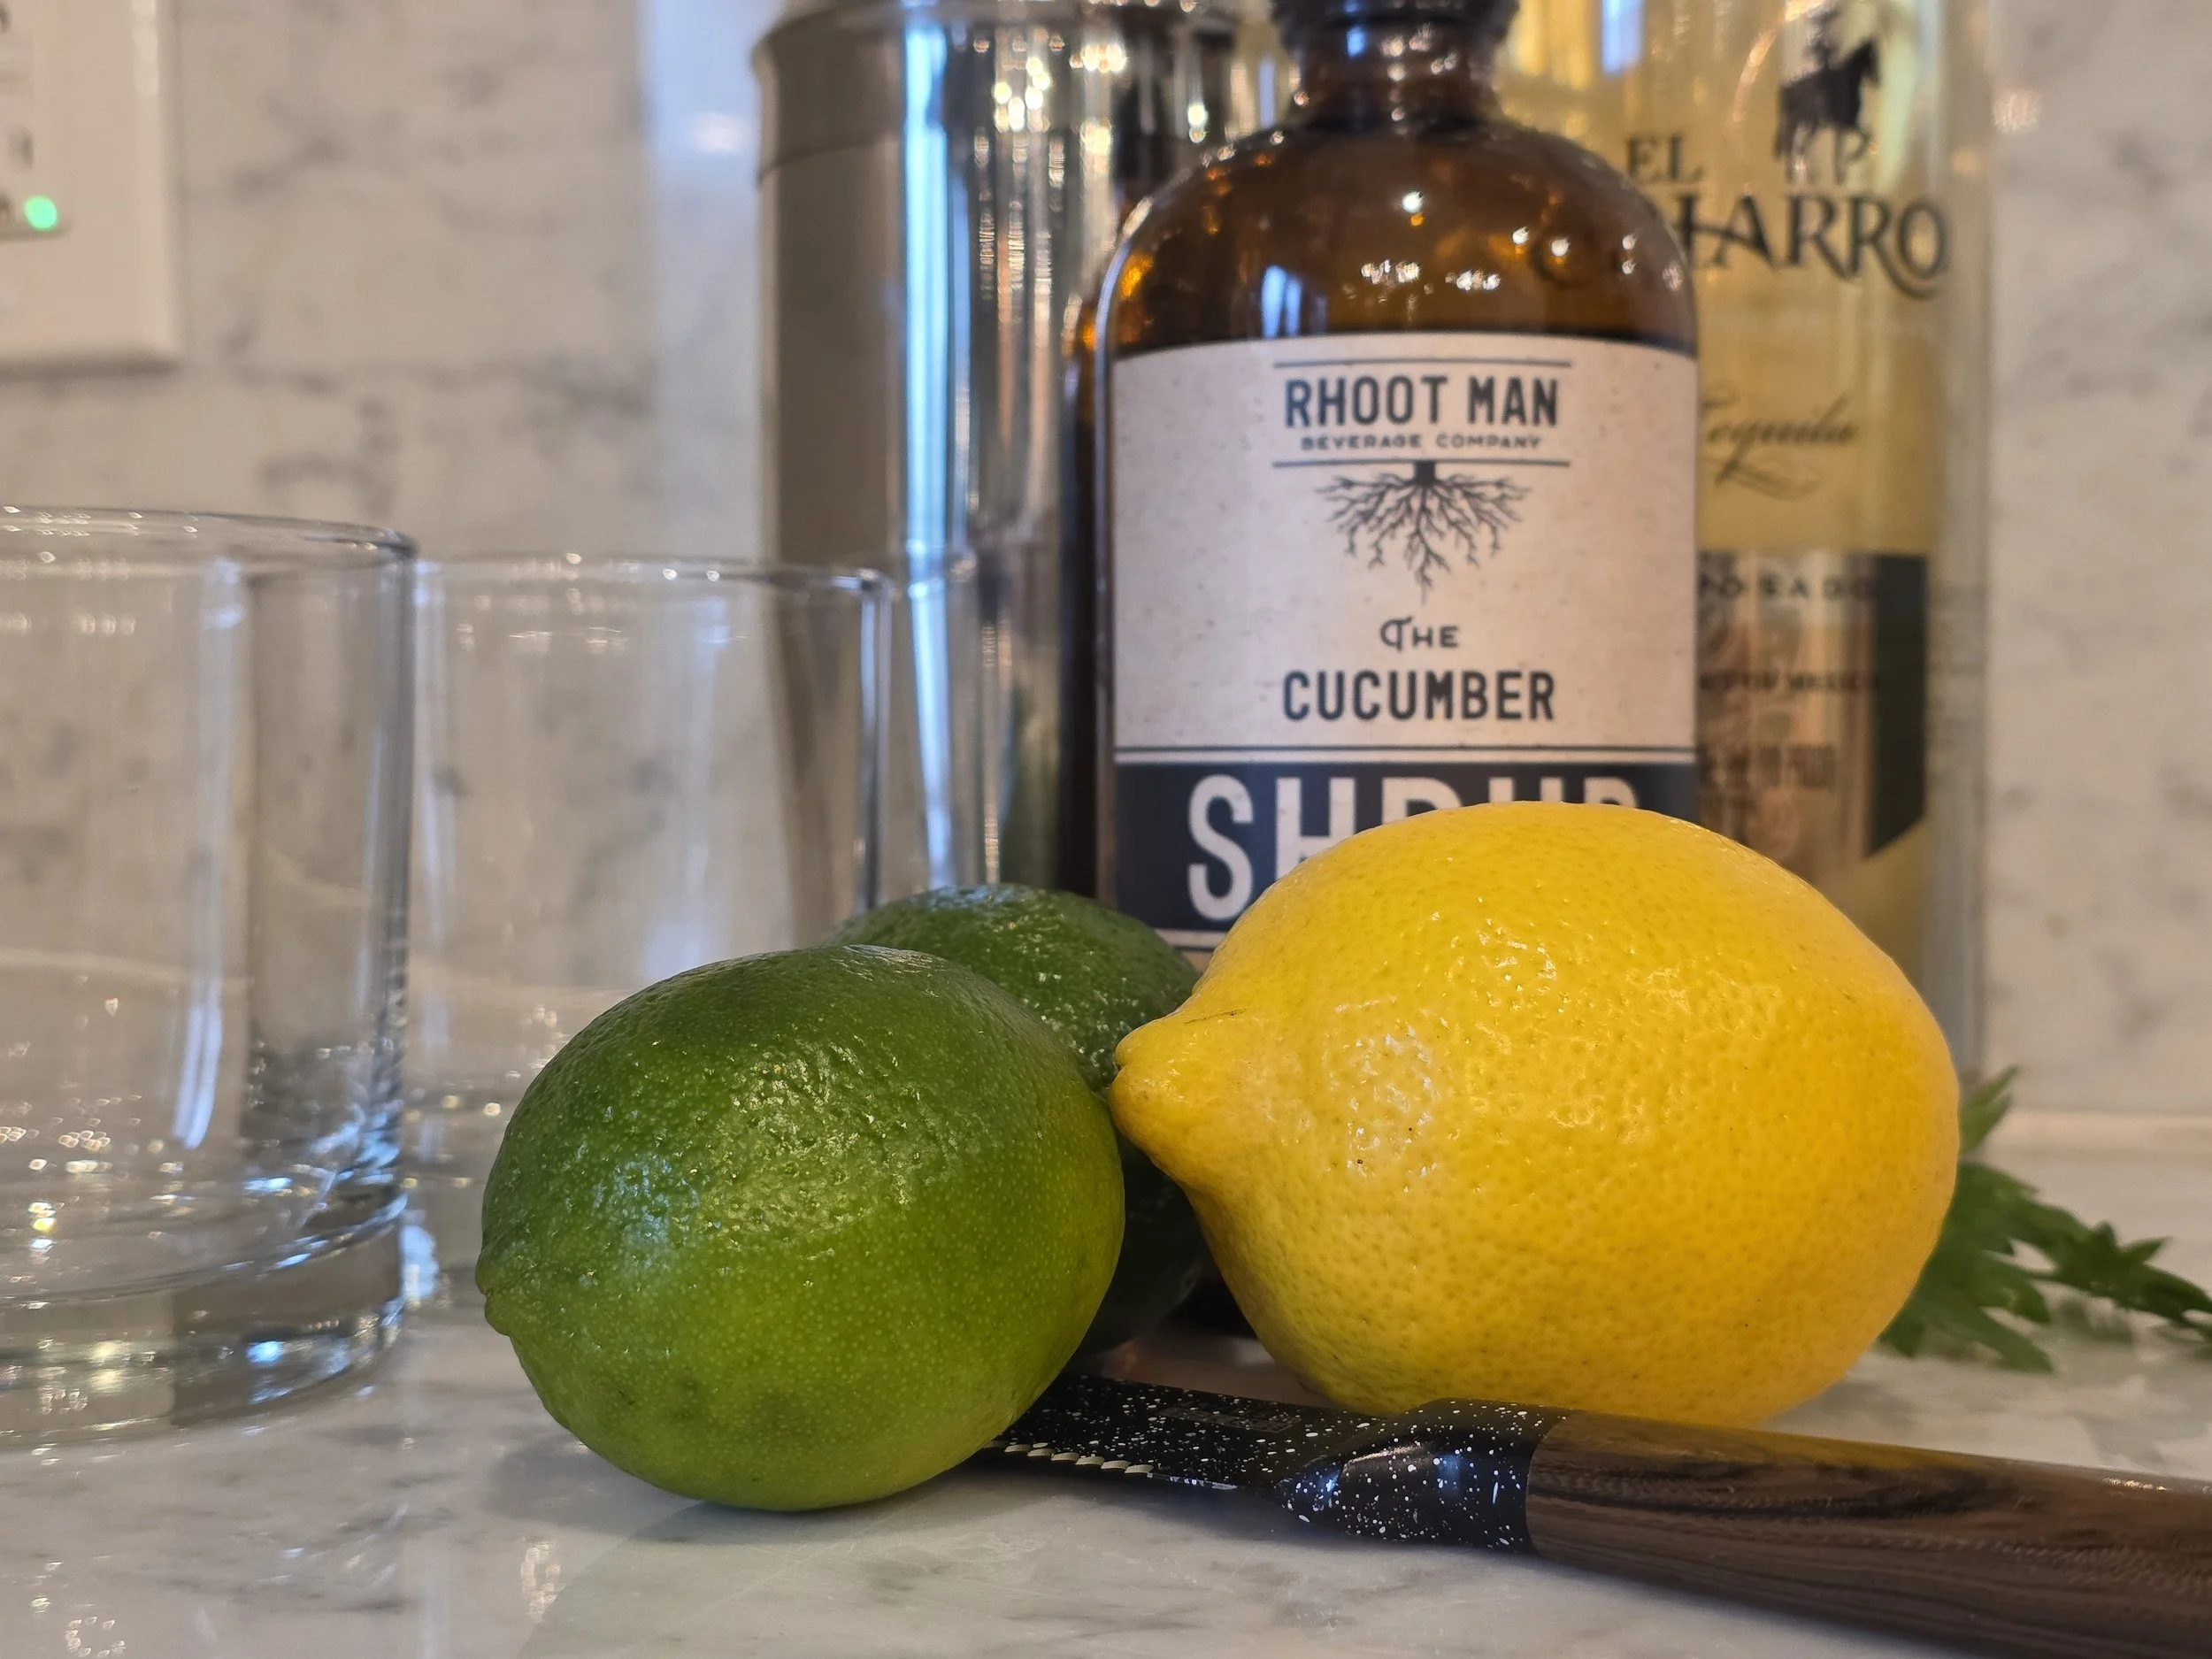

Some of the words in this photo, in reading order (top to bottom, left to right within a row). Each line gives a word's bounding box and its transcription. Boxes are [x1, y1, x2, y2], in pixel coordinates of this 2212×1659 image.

[1625, 134, 1704, 181] EL
[1675, 191, 1952, 299] ARRO
[1285, 375, 1448, 427] RHOOT
[1468, 375, 1558, 427] MAN
[1301, 434, 1422, 450] BEVERAGE
[1435, 433, 1542, 449] COMPANY
[1283, 670, 1555, 721] CUCUMBER
